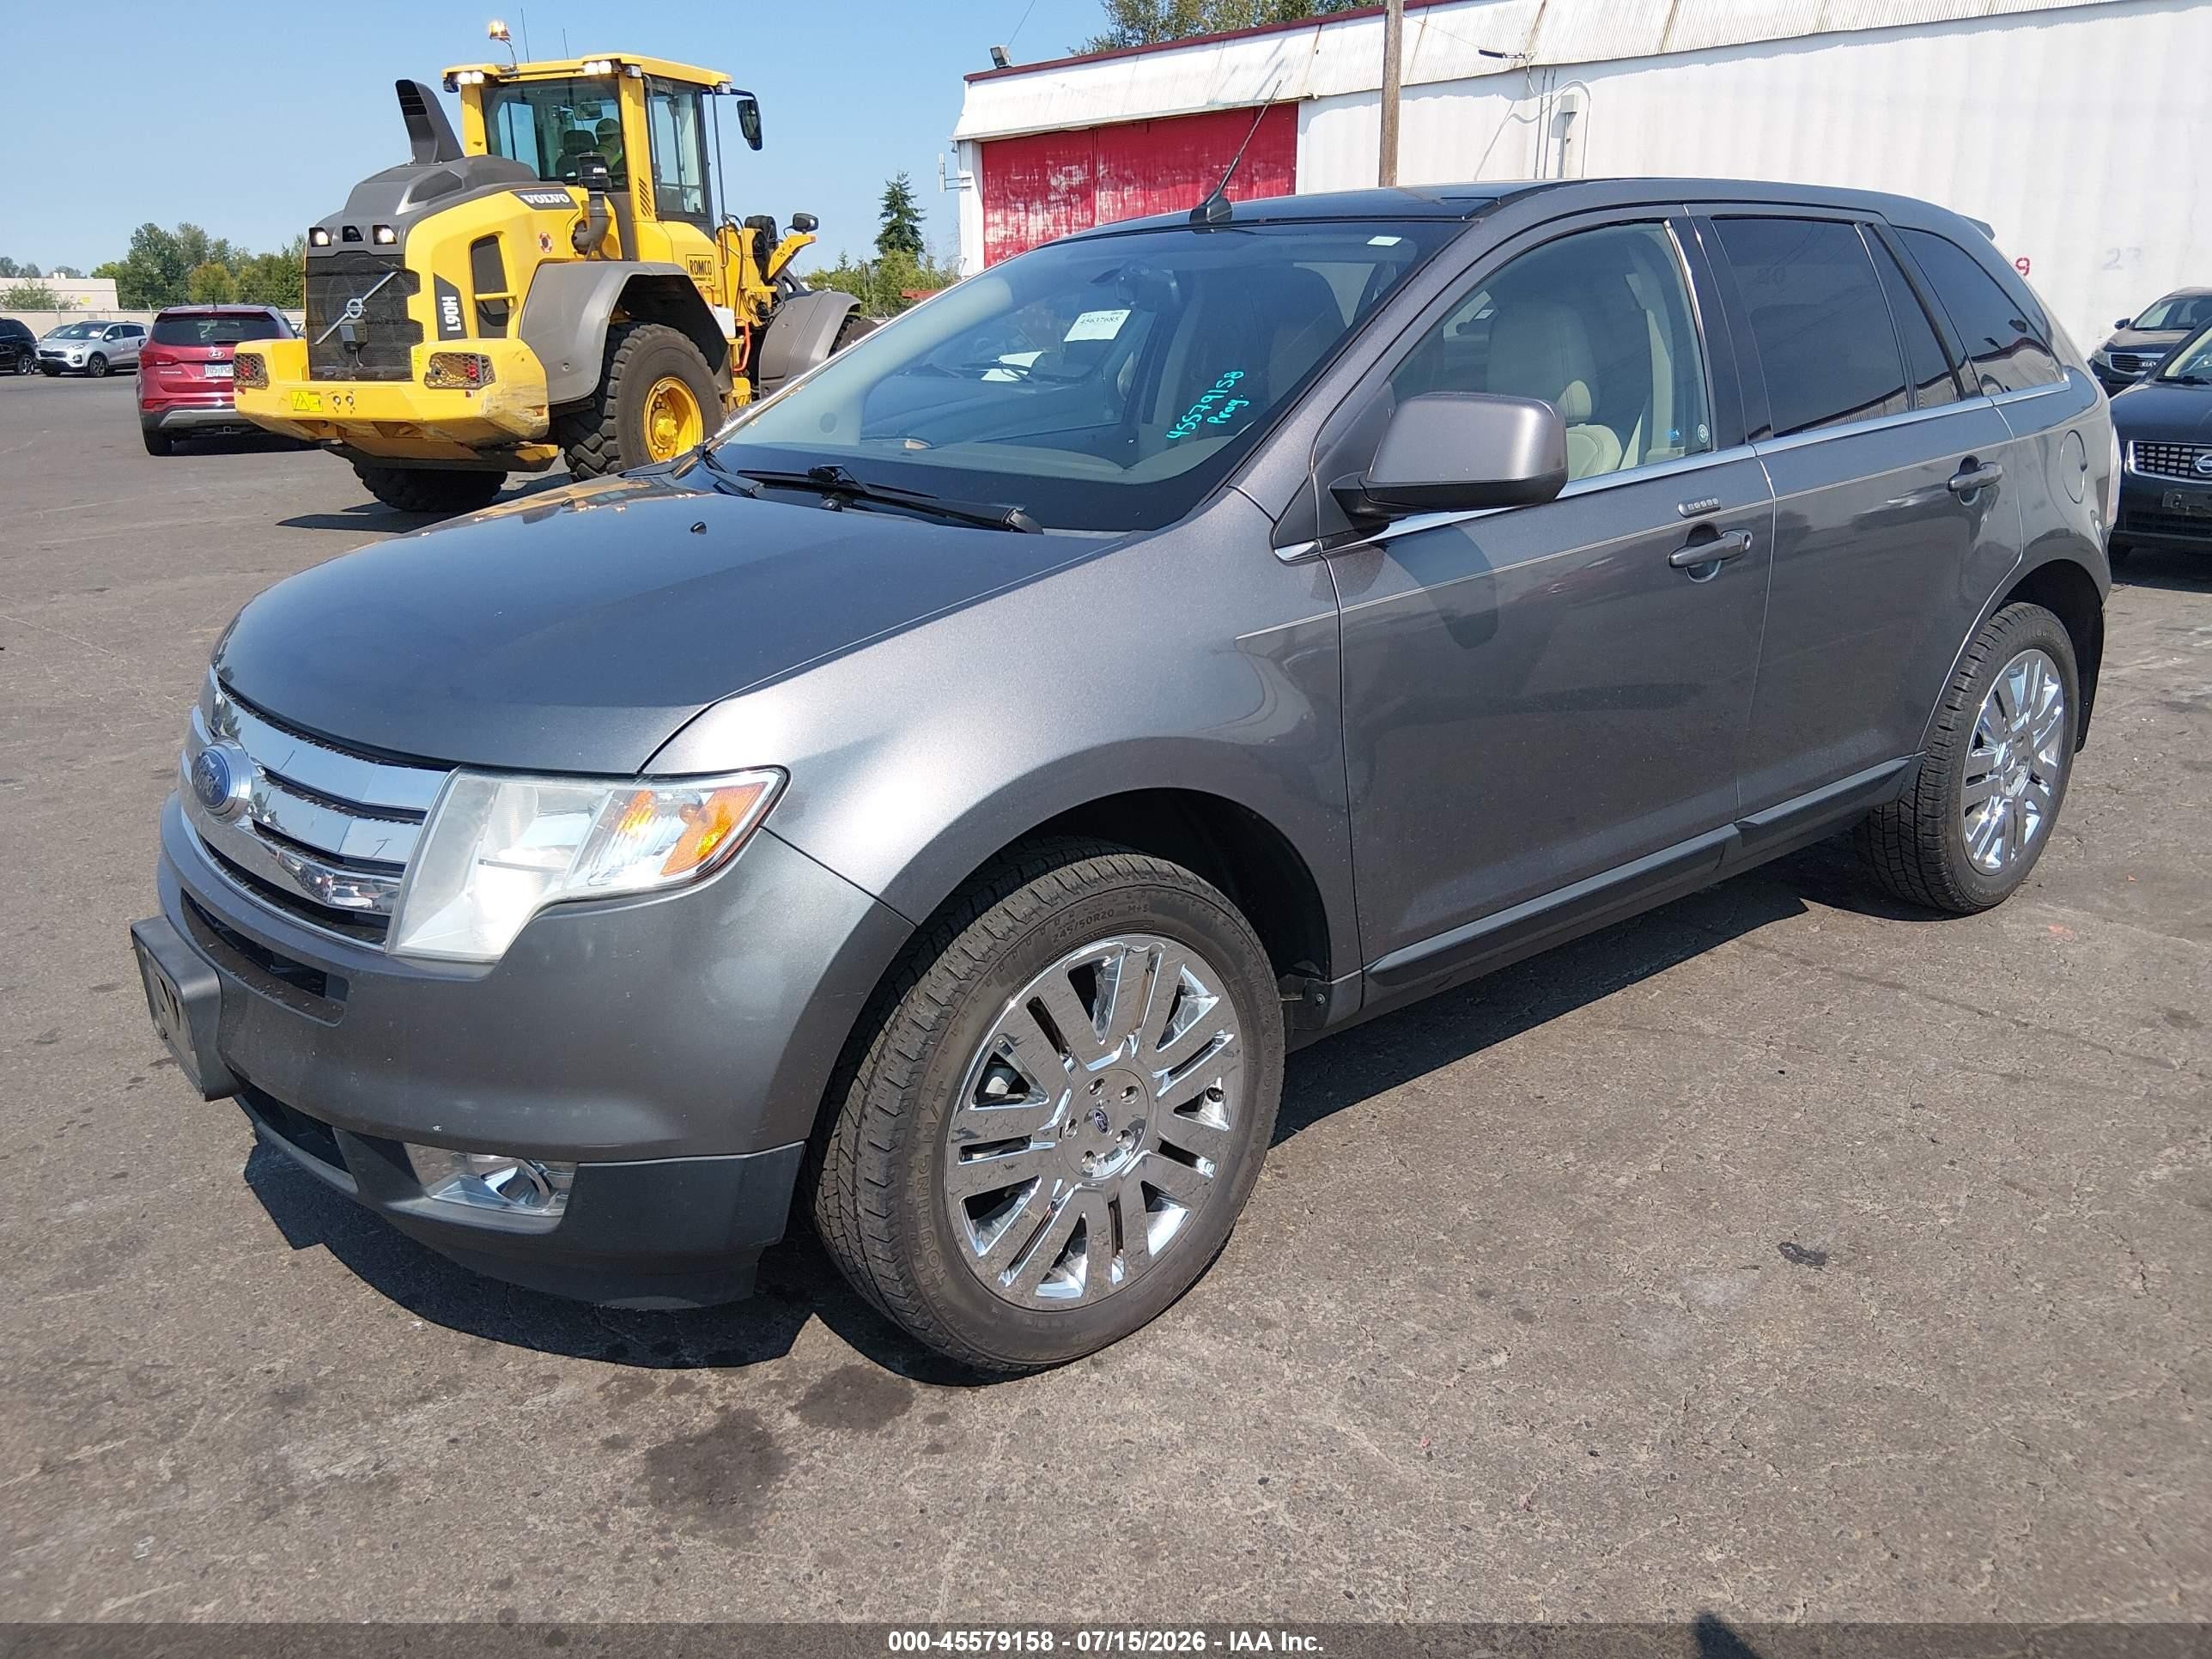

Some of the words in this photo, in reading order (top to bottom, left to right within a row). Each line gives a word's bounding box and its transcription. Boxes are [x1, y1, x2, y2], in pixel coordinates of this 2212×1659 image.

[520, 194, 570, 204] VOLVO
[690, 259, 713, 276] ROMCO
[441, 296, 462, 331] L90H
[1166, 371, 1244, 439] 45579158
[917, 1154, 947, 1285] TOURING
